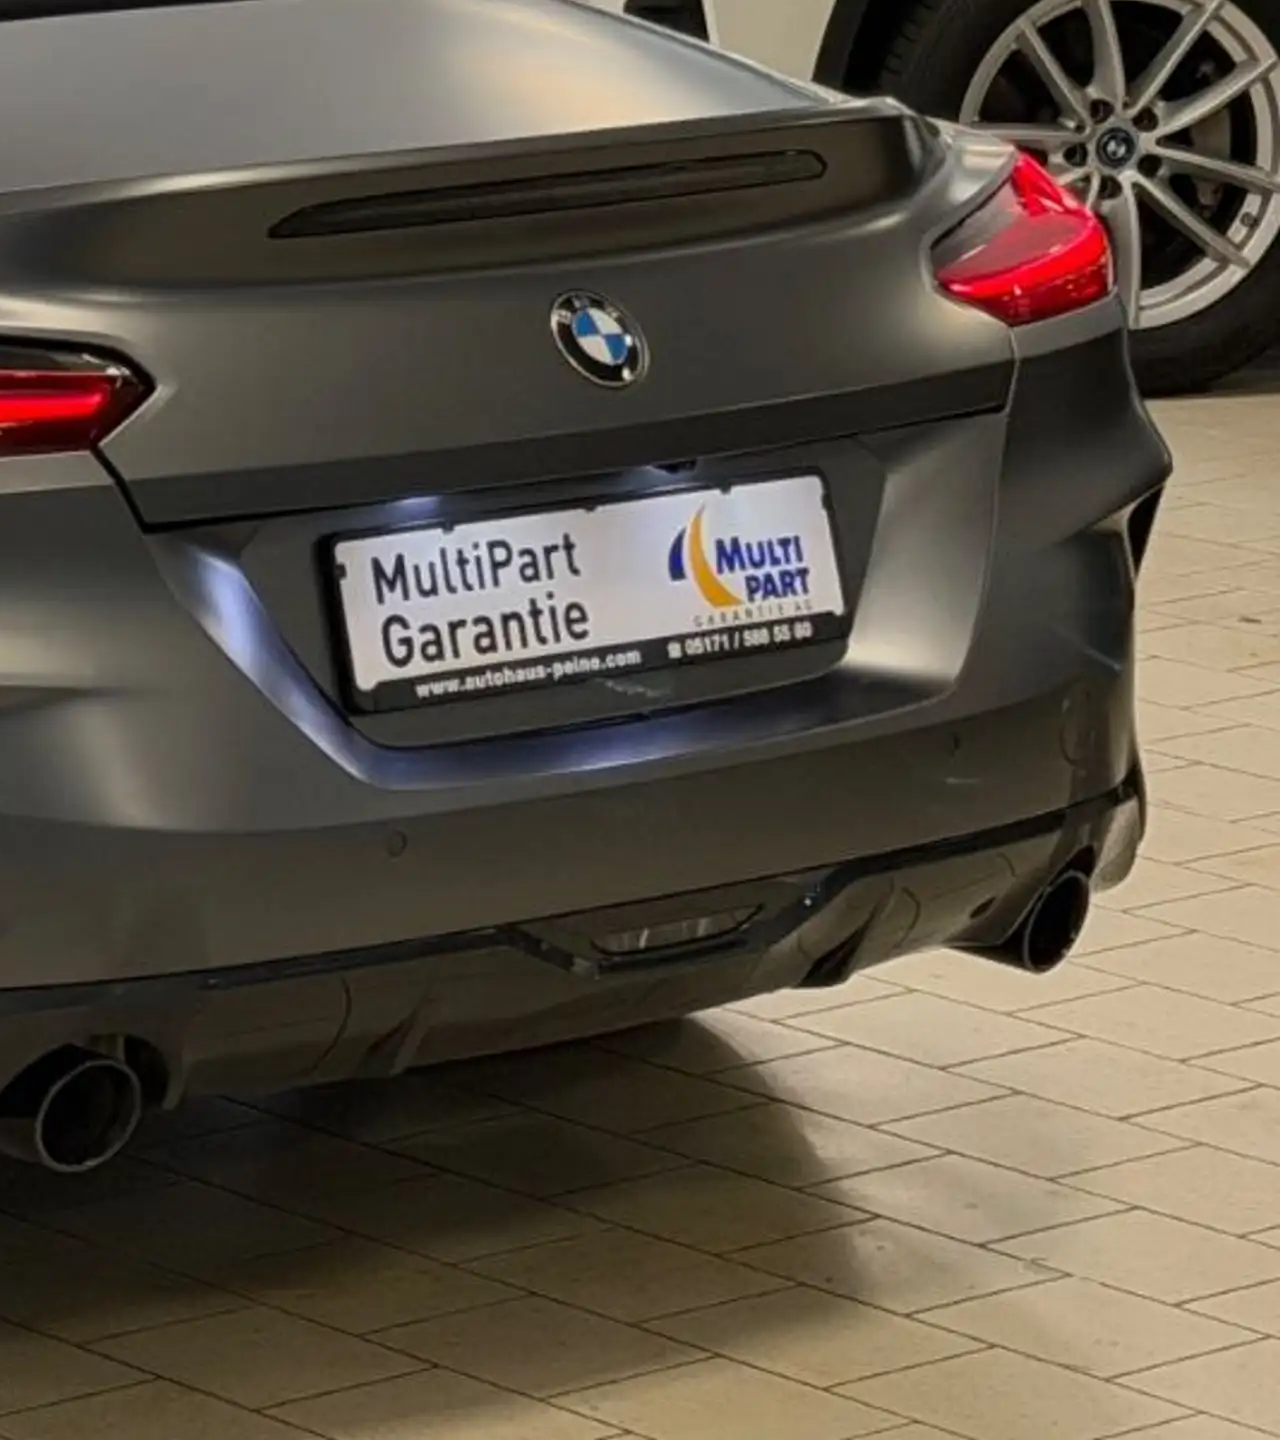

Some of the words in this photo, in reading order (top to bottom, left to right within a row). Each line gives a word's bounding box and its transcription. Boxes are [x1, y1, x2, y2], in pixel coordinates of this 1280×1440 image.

[371, 532, 581, 605] MultiPart
[715, 535, 804, 575] MULTI
[744, 567, 811, 602] PART
[381, 590, 590, 668] Garantie
[415, 649, 643, 698] www.autohaus-peine.com
